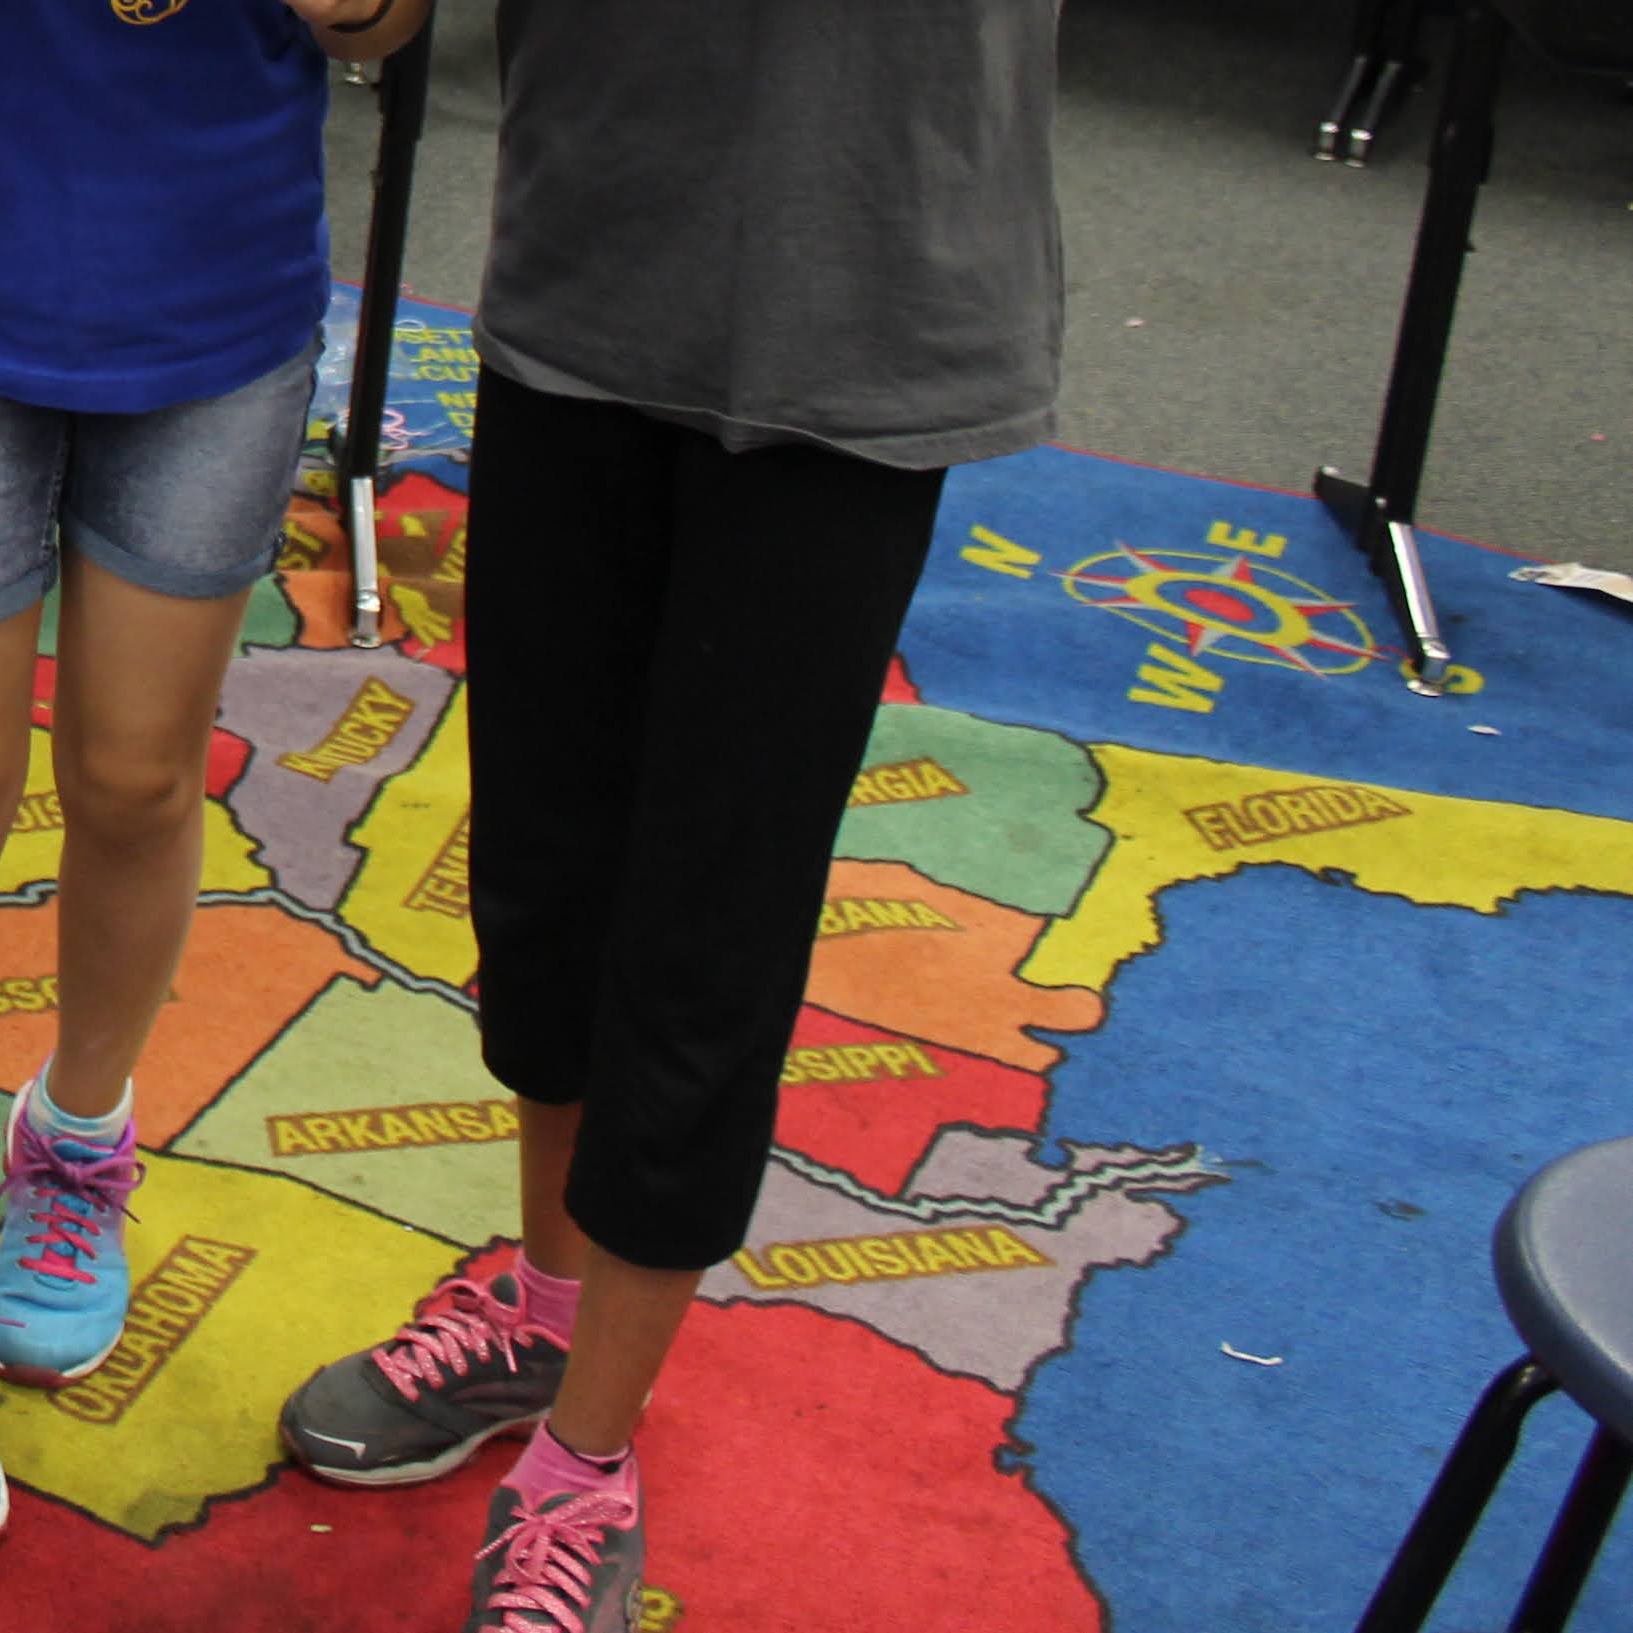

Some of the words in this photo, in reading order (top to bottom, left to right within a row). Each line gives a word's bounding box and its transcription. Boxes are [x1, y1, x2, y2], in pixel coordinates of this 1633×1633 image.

[960, 524, 1043, 580] N
[1206, 519, 1288, 559] E
[1129, 644, 1225, 715] W
[1191, 786, 1393, 850] FLORIDA
[273, 1101, 521, 1157] ARKANSA
[737, 1227, 1040, 1291] LOUISIANA
